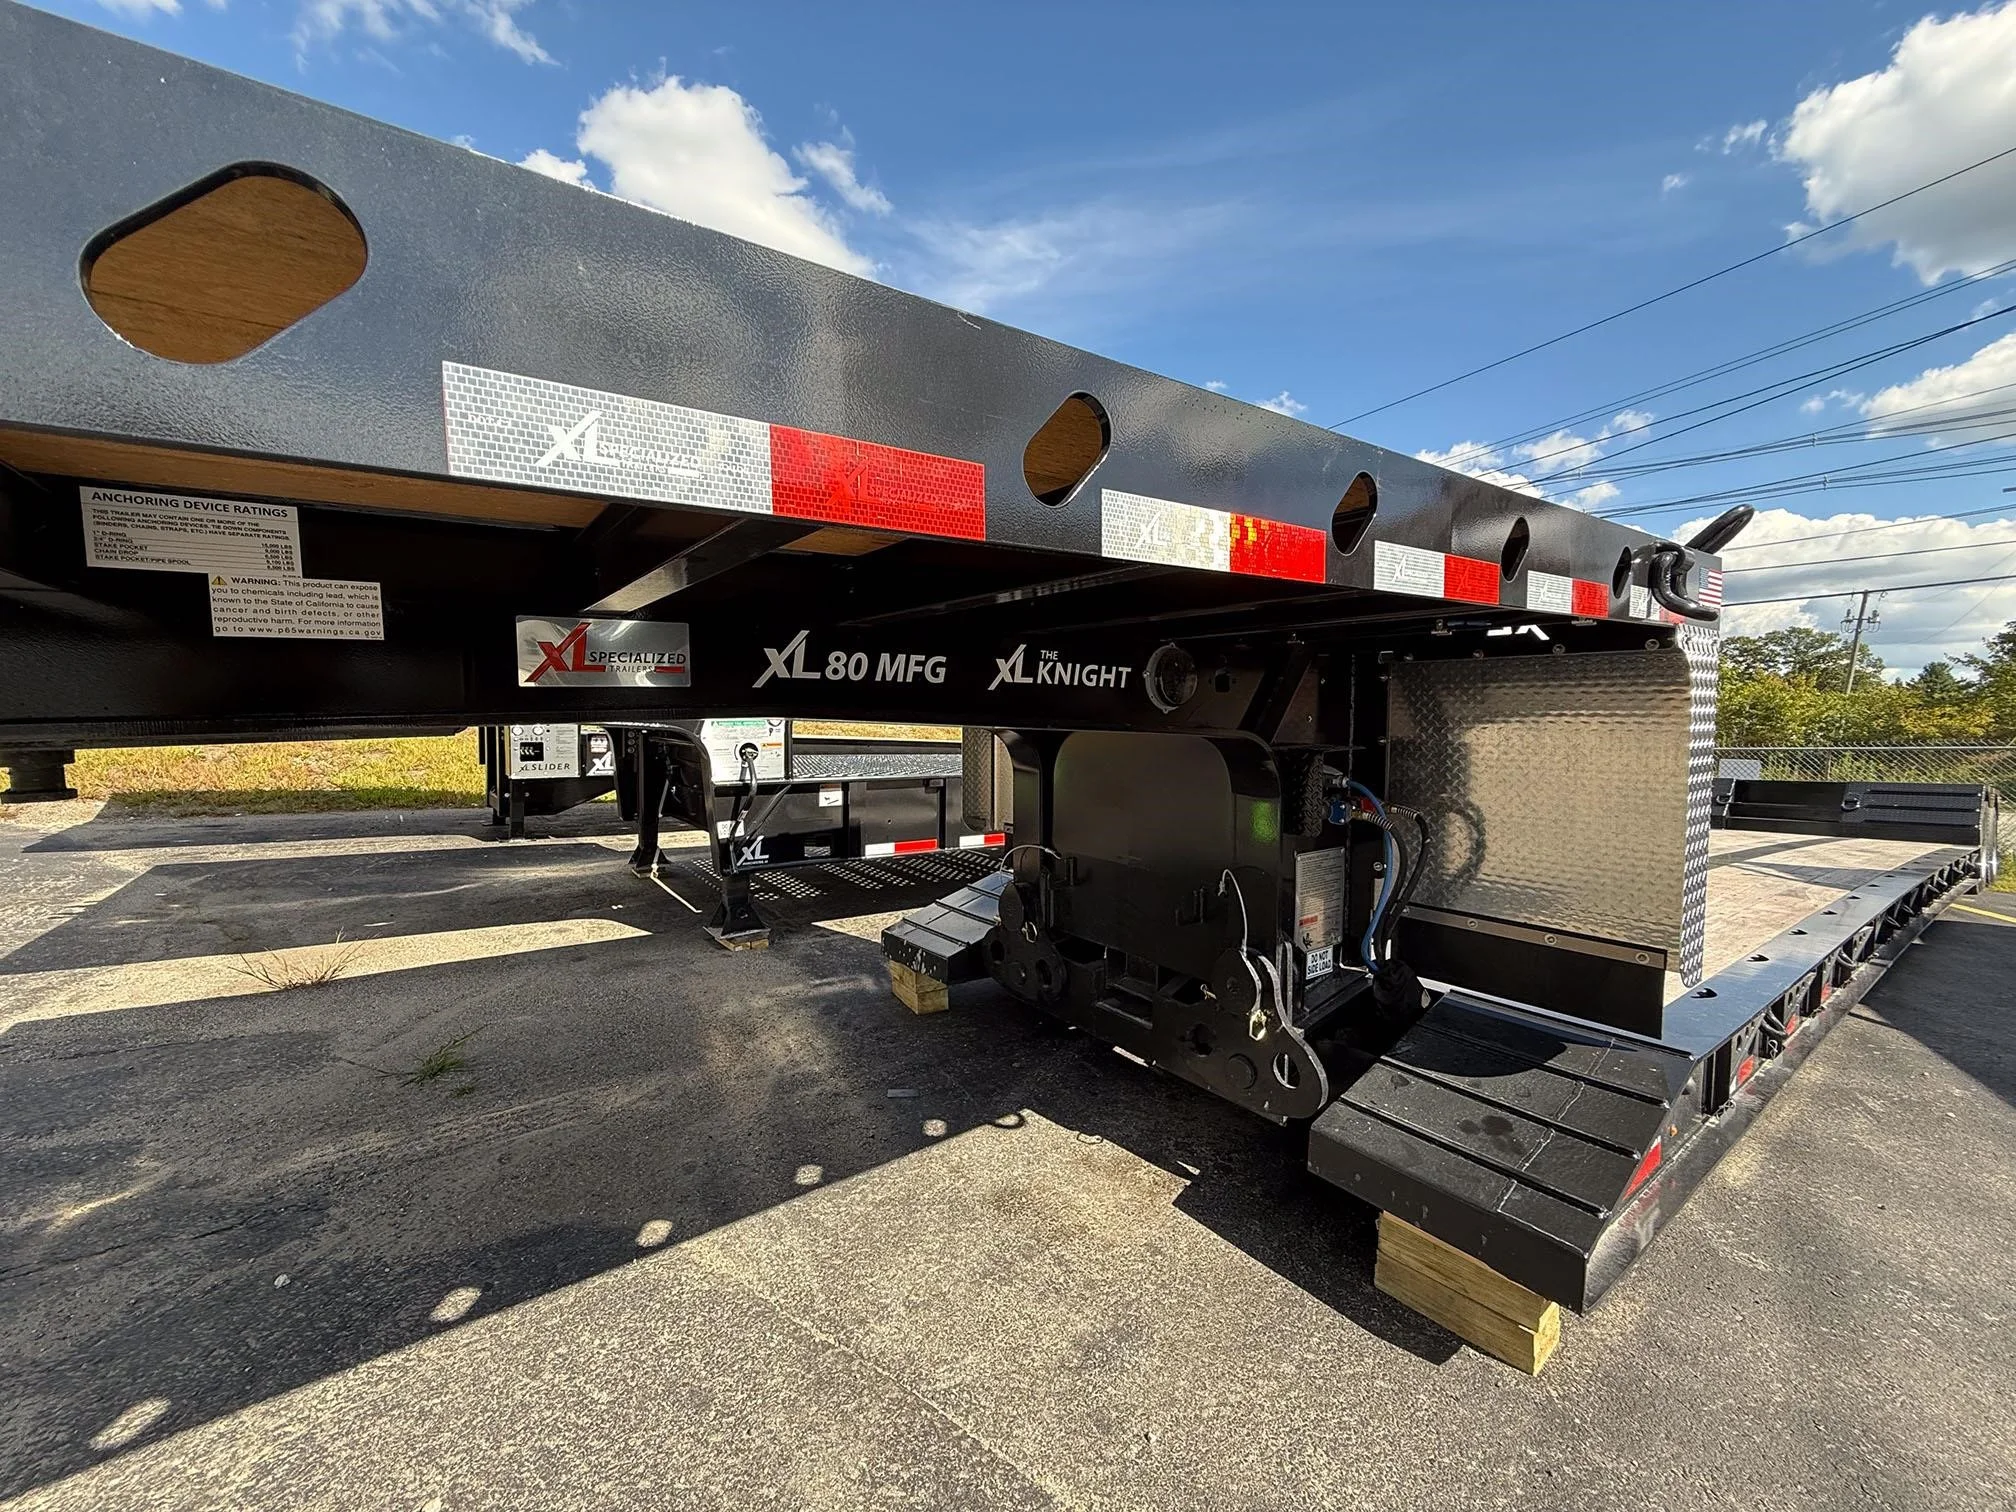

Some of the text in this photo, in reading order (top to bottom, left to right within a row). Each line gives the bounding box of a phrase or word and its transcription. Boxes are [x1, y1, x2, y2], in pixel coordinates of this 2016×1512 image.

[534, 410, 619, 467] XL
[91, 491, 288, 518] ANCHORING DEVICE RATINGS
[92, 515, 135, 523] FOLLOWING
[137, 519, 179, 527] ANCHORING
[243, 527, 287, 535] COMPONENTS
[92, 520, 129, 529] (BINDERS,
[130, 523, 159, 531] CHAINS,
[160, 526, 189, 534] STRAPS,
[230, 576, 281, 586] WARNING:
[350, 584, 378, 592] expose
[241, 588, 285, 596] chemicals
[286, 590, 324, 599] including
[325, 592, 345, 600] lead,
[211, 596, 241, 604] known
[254, 598, 269, 606] the
[270, 598, 293, 606] State
[305, 600, 345, 608] California
[212, 606, 248, 614] cancer
[274, 608, 298, 616] birth
[300, 609, 340, 618] defects,
[213, 616, 269, 624] reproductive
[270, 616, 296, 625] harm.
[337, 619, 381, 627] information
[248, 626, 382, 636] www.p65warnings.ca.gov
[523, 620, 607, 683] XL
[588, 651, 687, 665] SPECIALIZED
[751, 629, 947, 688] XL 80 MFG
[1040, 649, 1059, 660] THE
[609, 665, 655, 673] TRAILERS
[987, 643, 1132, 691] XL KNIGHT
[531, 763, 571, 771] SLIDER
[586, 751, 615, 776] XL
[736, 835, 770, 866] XL
[1311, 950, 1329, 964] DO NOT
[1307, 959, 1331, 975] SIDE LOAD
